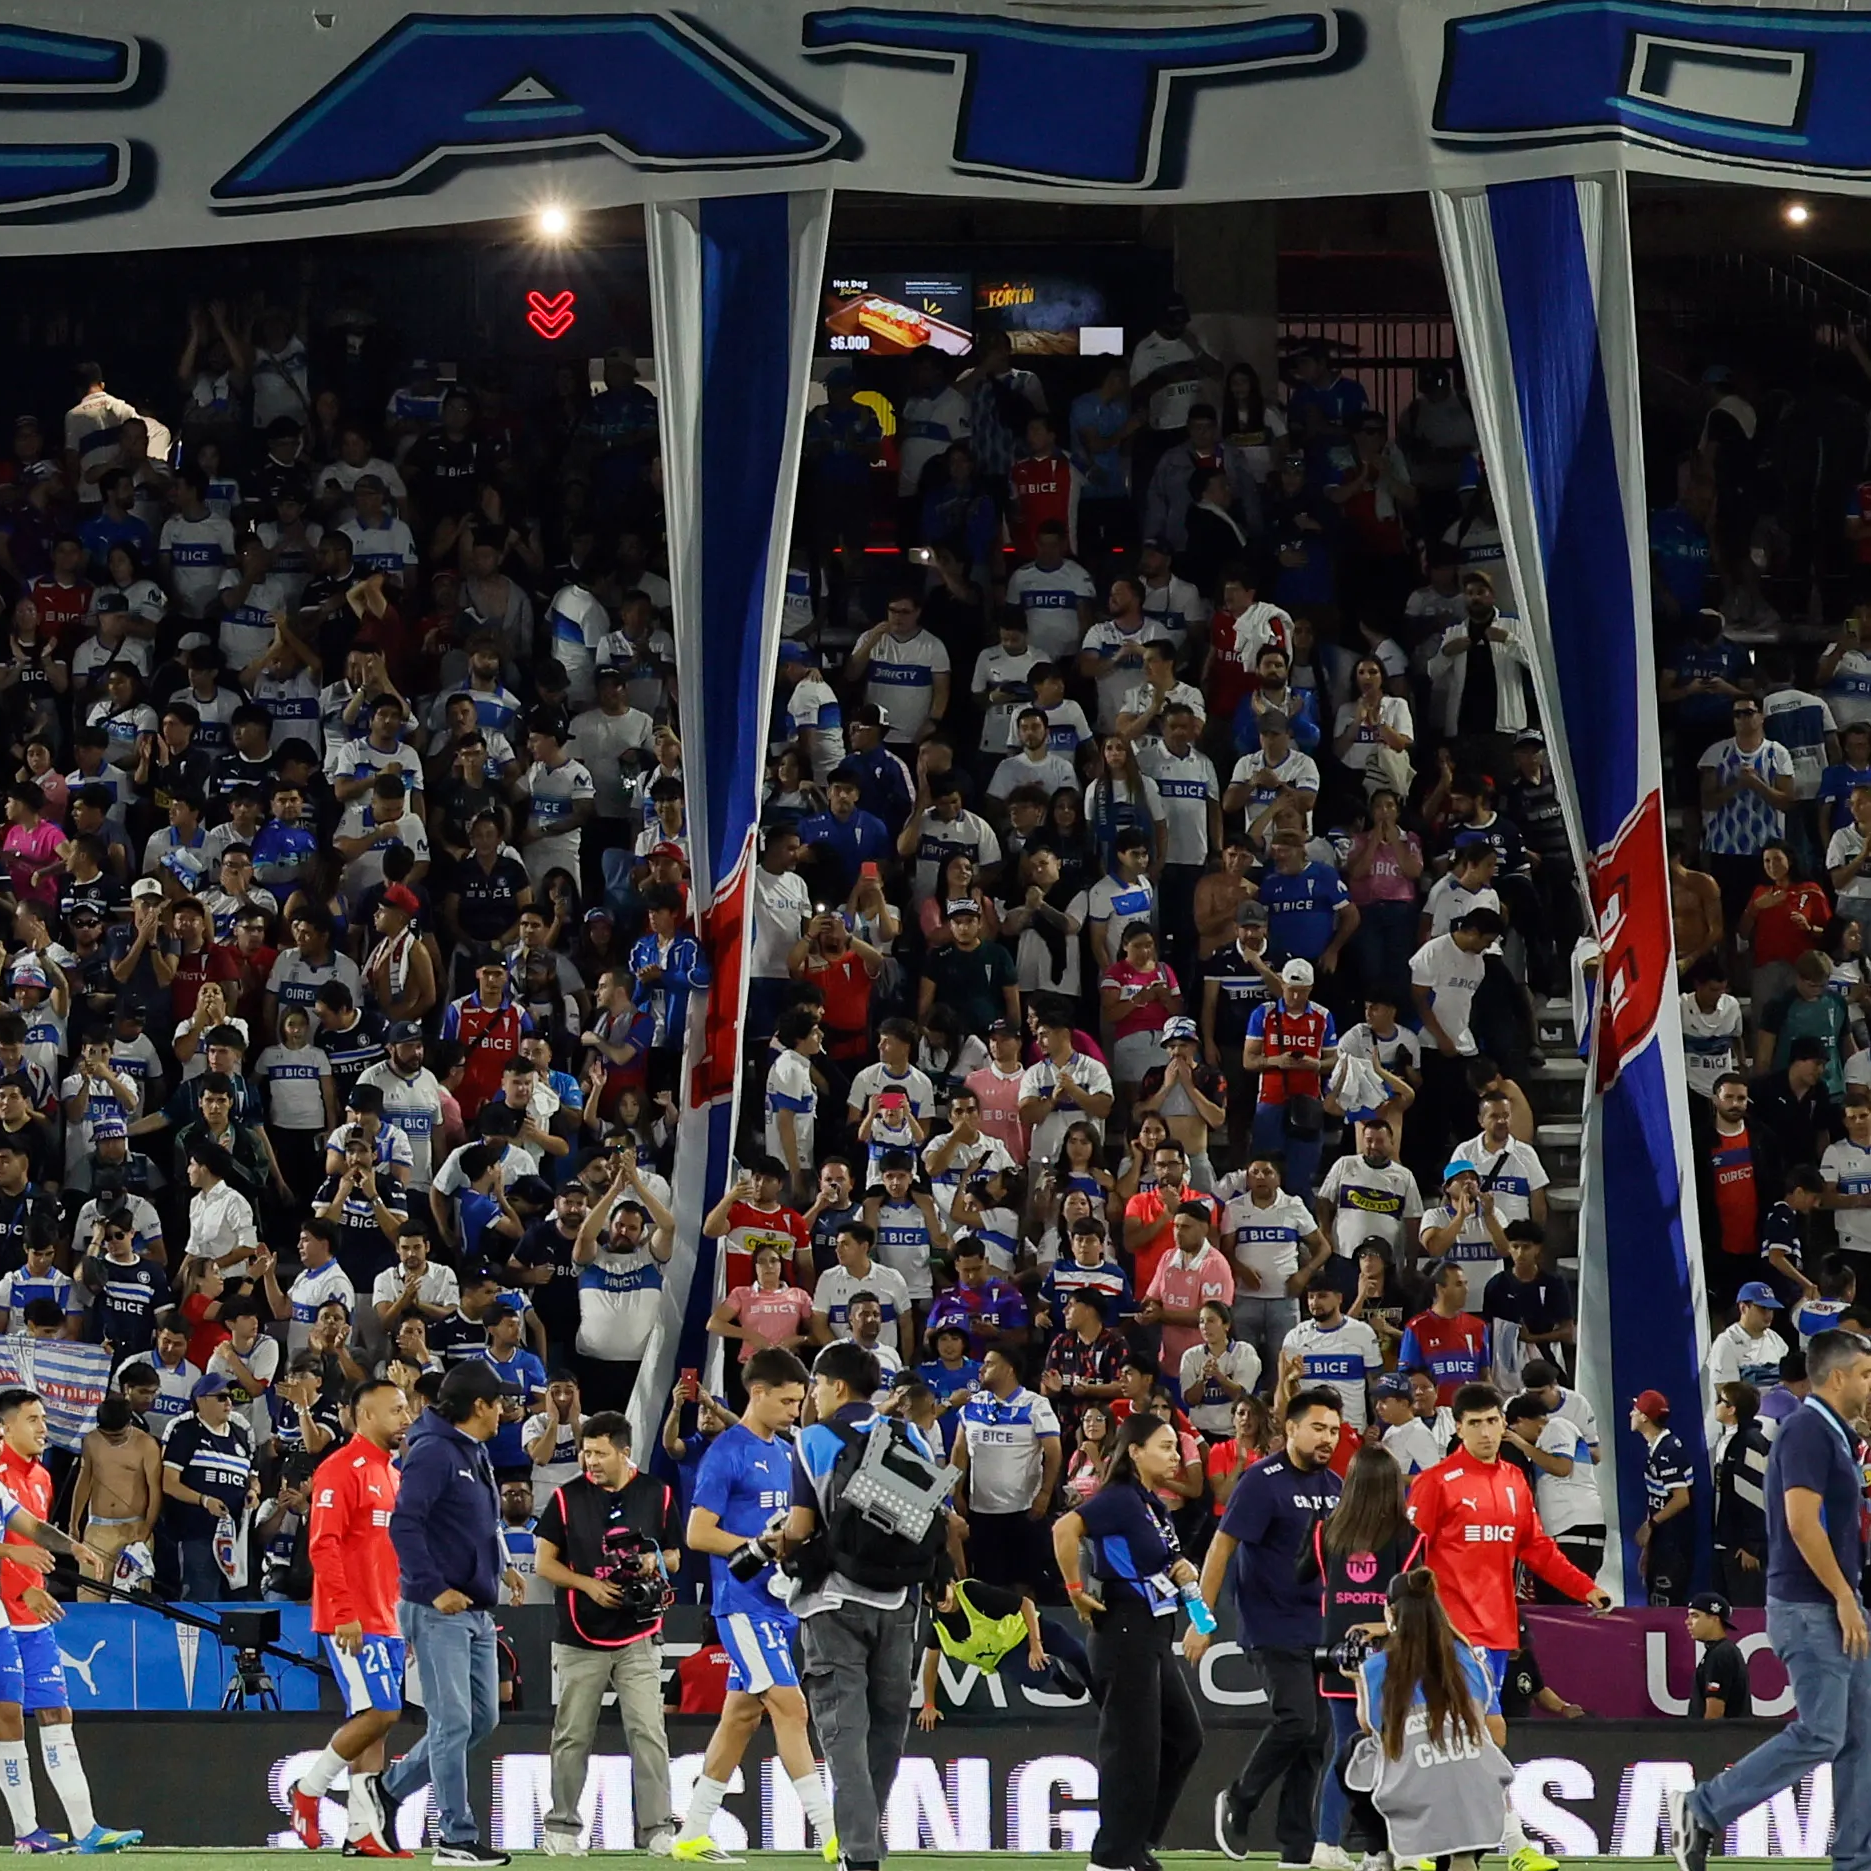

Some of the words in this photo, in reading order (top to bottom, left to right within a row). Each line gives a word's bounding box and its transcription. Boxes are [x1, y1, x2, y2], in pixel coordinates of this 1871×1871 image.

[833, 279, 849, 288] Hot
[849, 279, 868, 290] Dog
[830, 335, 871, 351] $6.000
[1027, 482, 1058, 494] BICE
[1036, 596, 1066, 607] BICE
[1173, 784, 1206, 797] BICE
[1282, 899, 1313, 910] BICE
[1240, 988, 1271, 1000] BICE
[481, 1039, 511, 1050] BICE
[1284, 1034, 1316, 1048] BICE
[285, 1068, 314, 1078] BICE
[1346, 1190, 1398, 1211] CRISTAL
[350, 1216, 381, 1229] BICE
[889, 1232, 921, 1243] BICE
[889, 1232, 923, 1244] BICE
[1248, 1229, 1285, 1242] BICE
[604, 1273, 643, 1288] DIRECTV
[114, 1300, 144, 1314] BICE
[764, 1302, 797, 1314] BICE
[1314, 1361, 1348, 1373] BICE
[1446, 1360, 1474, 1374] BICE
[155, 1397, 188, 1412] BICE
[982, 1430, 1013, 1442] BICE
[218, 1472, 245, 1485] BICE
[1483, 1525, 1514, 1542] BICE
[1347, 1558, 1377, 1574] TNT
[1336, 1591, 1385, 1605] SPORTS
[1416, 1741, 1479, 1767] CLUB
